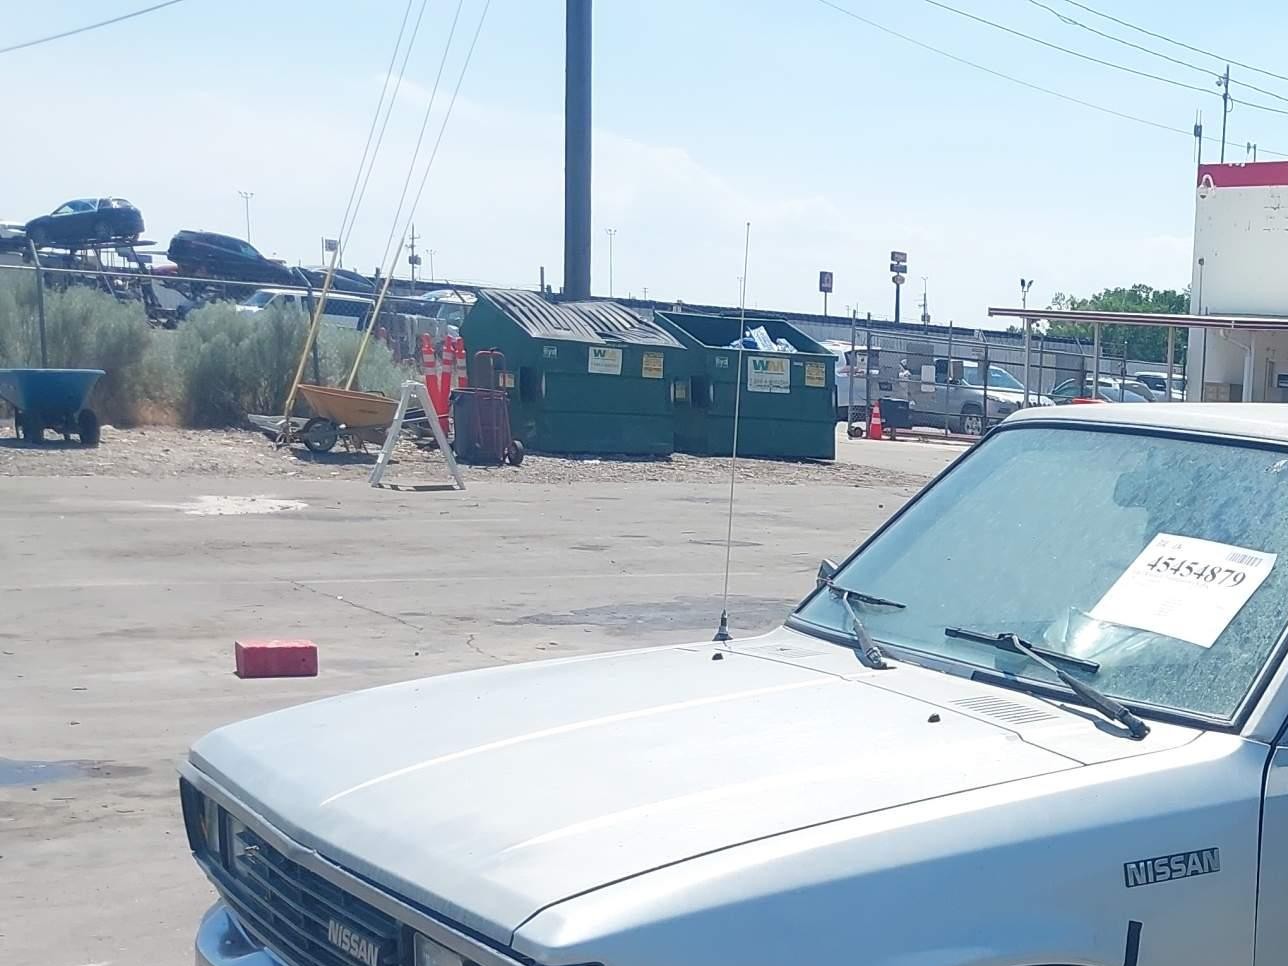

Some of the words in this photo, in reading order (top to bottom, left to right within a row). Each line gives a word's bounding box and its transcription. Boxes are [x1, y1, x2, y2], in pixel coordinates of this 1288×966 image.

[752, 359, 785, 371] WM
[1147, 556, 1247, 588] 45454879
[1124, 848, 1220, 887] NISSAN
